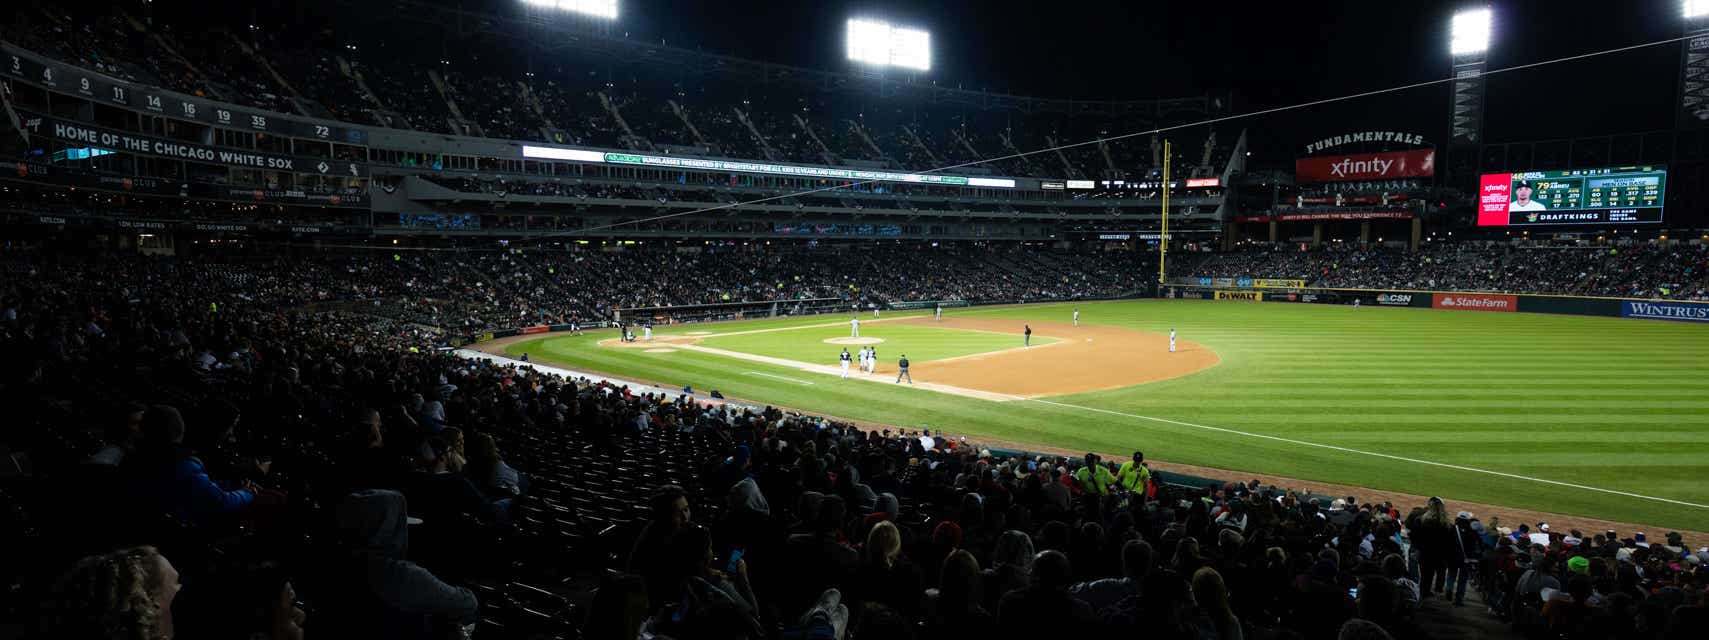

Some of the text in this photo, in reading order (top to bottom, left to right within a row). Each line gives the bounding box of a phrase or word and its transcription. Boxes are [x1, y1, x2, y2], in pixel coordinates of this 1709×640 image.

[12, 55, 20, 70] 3
[43, 68, 51, 80] 4
[81, 77, 89, 90] 9
[113, 87, 124, 99] 11
[146, 95, 160, 107] 14
[182, 102, 195, 114] 16
[217, 110, 230, 121] 19
[251, 115, 265, 126] 35
[315, 125, 328, 136] 72
[56, 123, 97, 143] HOME
[101, 132, 119, 146] OF
[123, 137, 150, 152] THE
[154, 142, 214, 161] CHICAGO
[219, 151, 264, 167] WHITE
[268, 158, 293, 170] SOX
[1306, 131, 1423, 153] FUNDAMENTALS
[1331, 157, 1393, 177] xfinity
[1390, 294, 1412, 302] CSN
[1456, 297, 1508, 307] State Farm
[1630, 302, 1709, 318] WINTRUS
